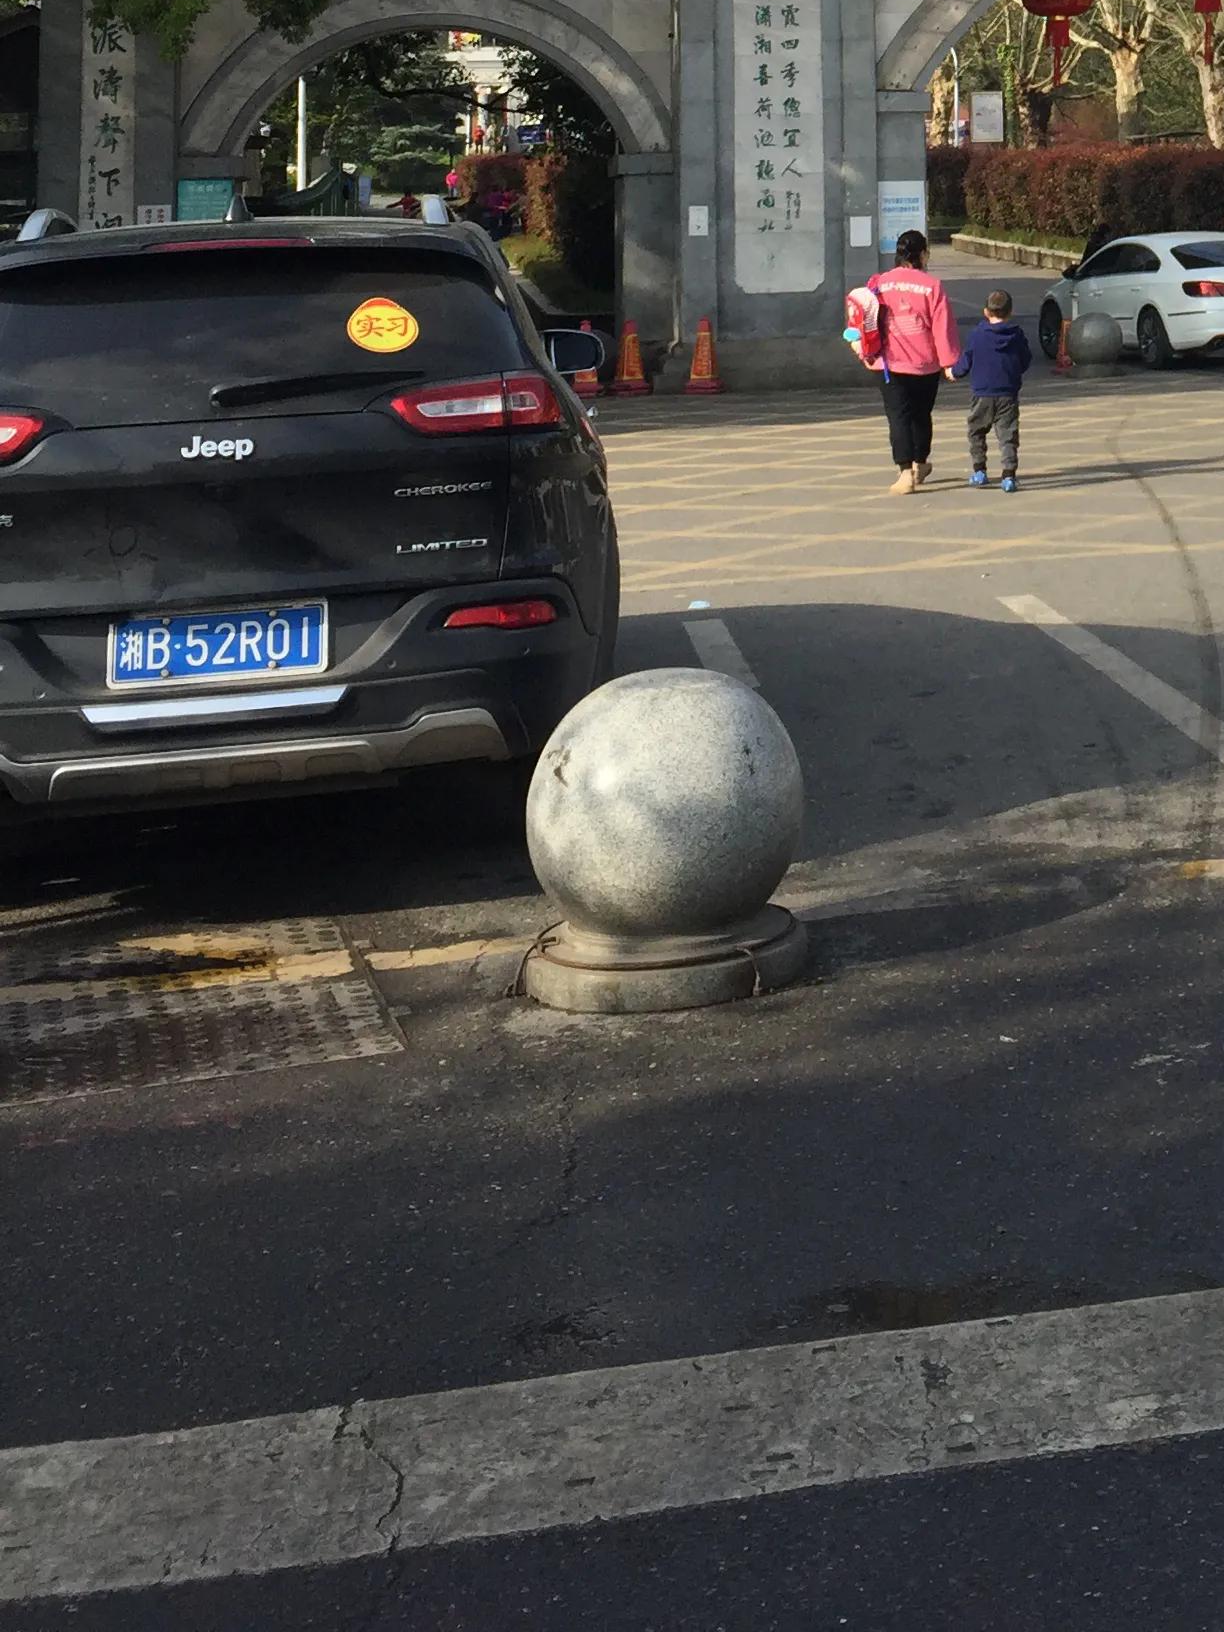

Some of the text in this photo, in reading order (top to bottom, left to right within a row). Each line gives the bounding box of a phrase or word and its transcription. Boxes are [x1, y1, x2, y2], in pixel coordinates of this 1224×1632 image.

[355, 315, 410, 339] 实习
[181, 436, 254, 460] Jeep
[394, 481, 493, 498] CHEROKEE
[396, 537, 489, 554] LIMITED
